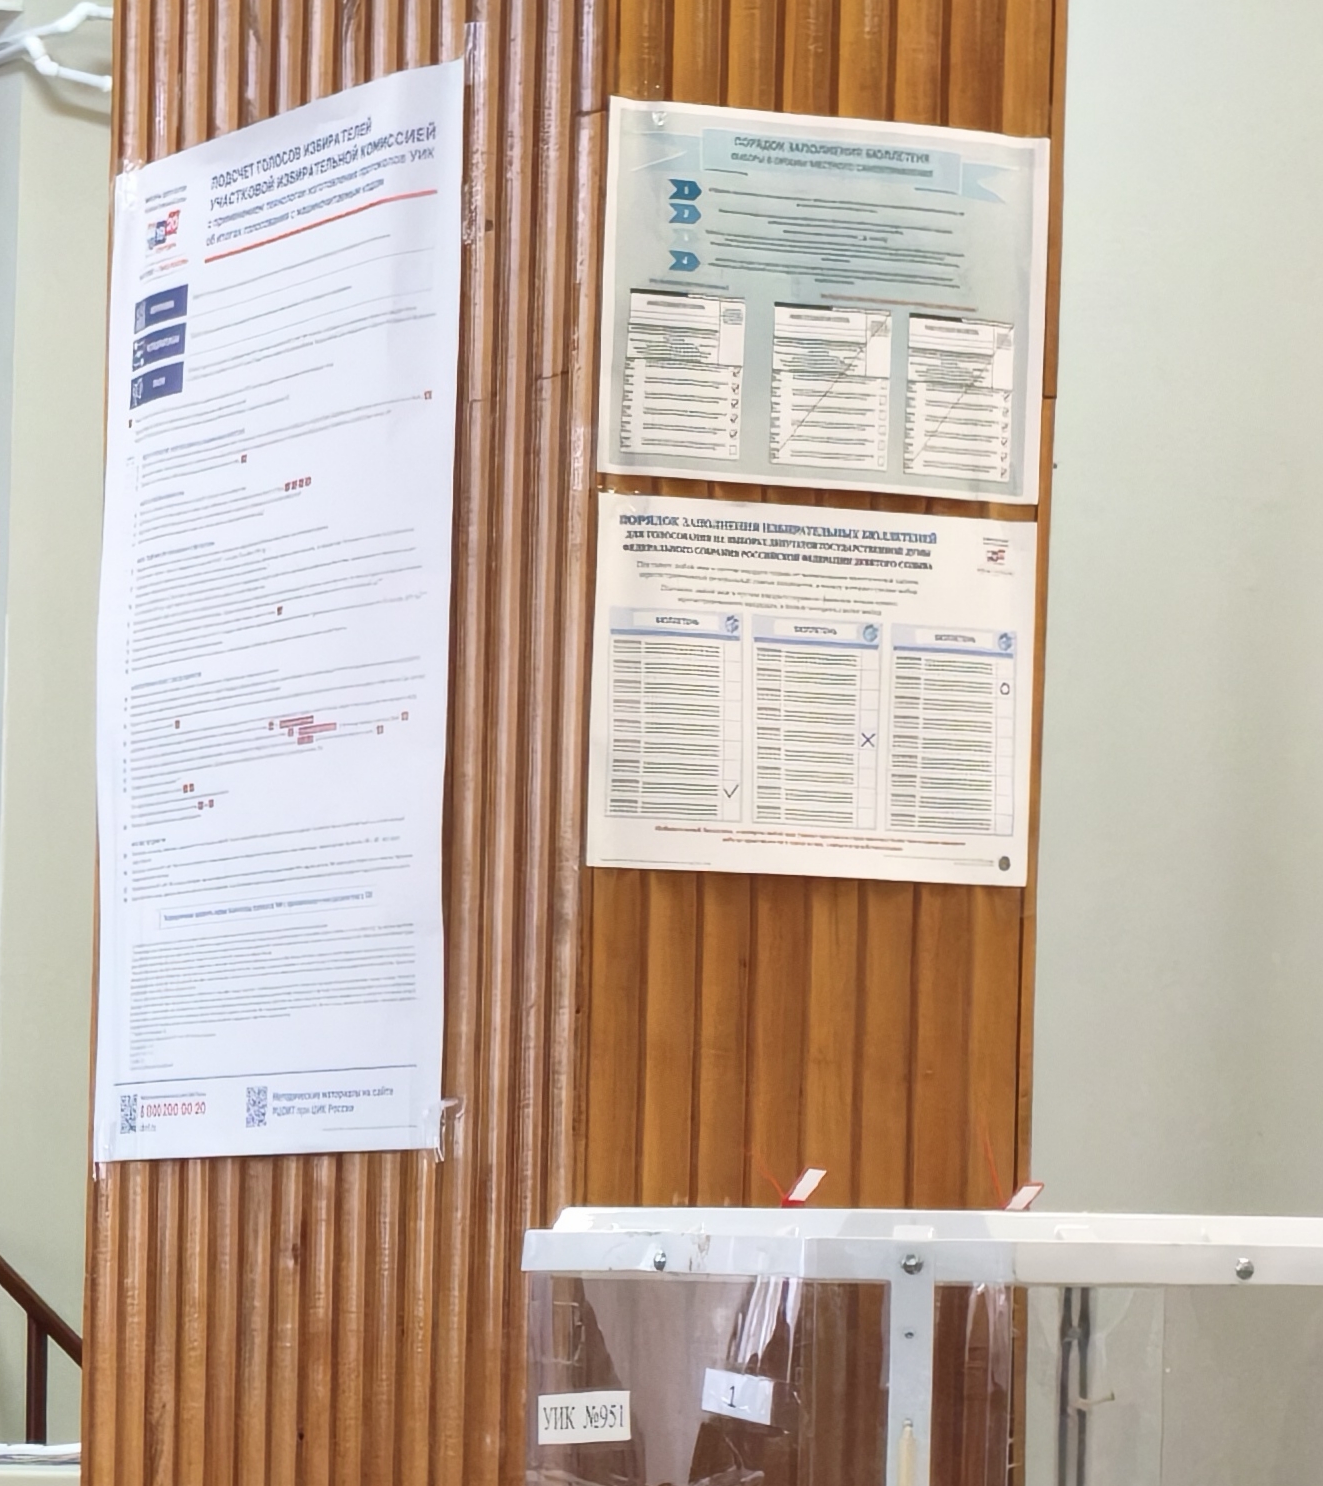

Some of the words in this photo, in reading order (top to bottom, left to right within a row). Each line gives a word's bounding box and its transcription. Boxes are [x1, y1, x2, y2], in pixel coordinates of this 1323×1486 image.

[256, 147, 301, 174] ГОЛОСОВ
[303, 117, 372, 157] ИЗБИРАТЕЛЕЙ
[210, 175, 275, 211] УЧАСТКОВОЙ
[276, 144, 359, 190] ИЗБИРАТЕЛЬНОЙ
[361, 122, 437, 158] КОМИССИЕЙ
[543, 1406, 575, 1430] УИК
[583, 1404, 624, 1429] №951
[729, 1386, 736, 1408] 1
